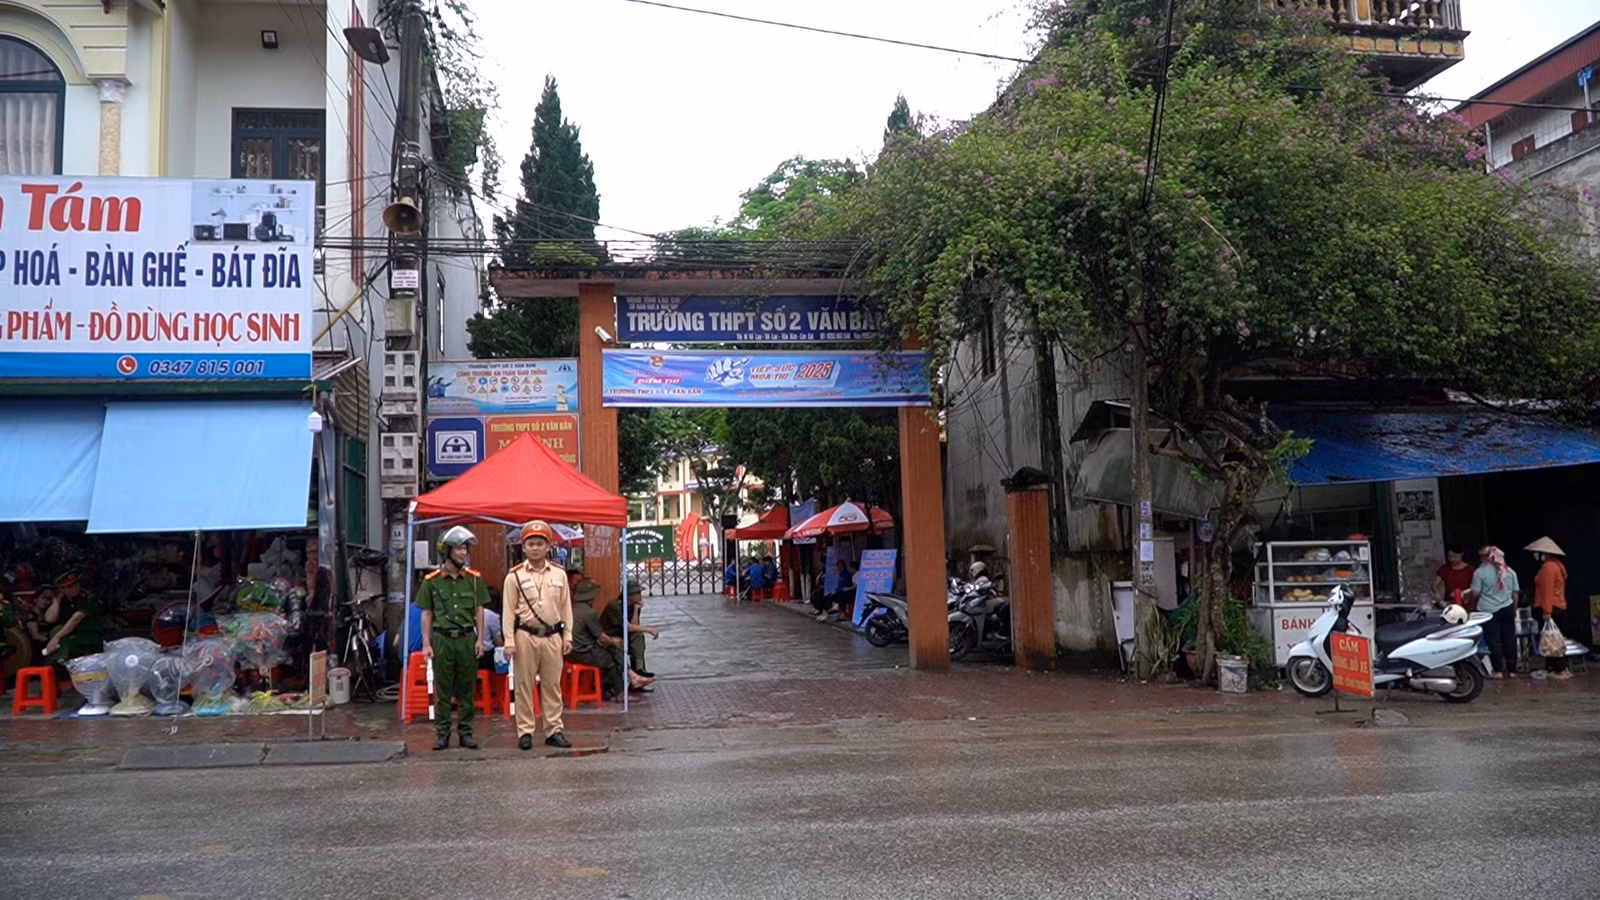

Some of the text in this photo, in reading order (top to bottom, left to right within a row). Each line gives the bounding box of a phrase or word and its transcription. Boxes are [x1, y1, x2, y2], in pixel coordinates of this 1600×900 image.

[21, 181, 142, 232] Tám
[13, 242, 61, 286] HOÁ
[85, 243, 134, 287] BÀN
[142, 240, 191, 288] GHẾ
[211, 245, 256, 288] BÁT
[262, 246, 302, 288] ĐĨA
[7, 297, 72, 341] PHẨM
[88, 301, 122, 341] ĐỒ
[126, 307, 187, 341] DÙNG
[193, 311, 243, 348] HỌC
[246, 313, 301, 342] SINH
[626, 308, 705, 331] TRƯỜNG
[709, 311, 756, 331] THPT
[760, 305, 787, 331] SỐ
[789, 311, 802, 331] 2
[806, 306, 847, 331] VĂN
[150, 360, 264, 374] 0347 815 001
[795, 361, 833, 380] 2025
[1338, 636, 1359, 653] CẤM
